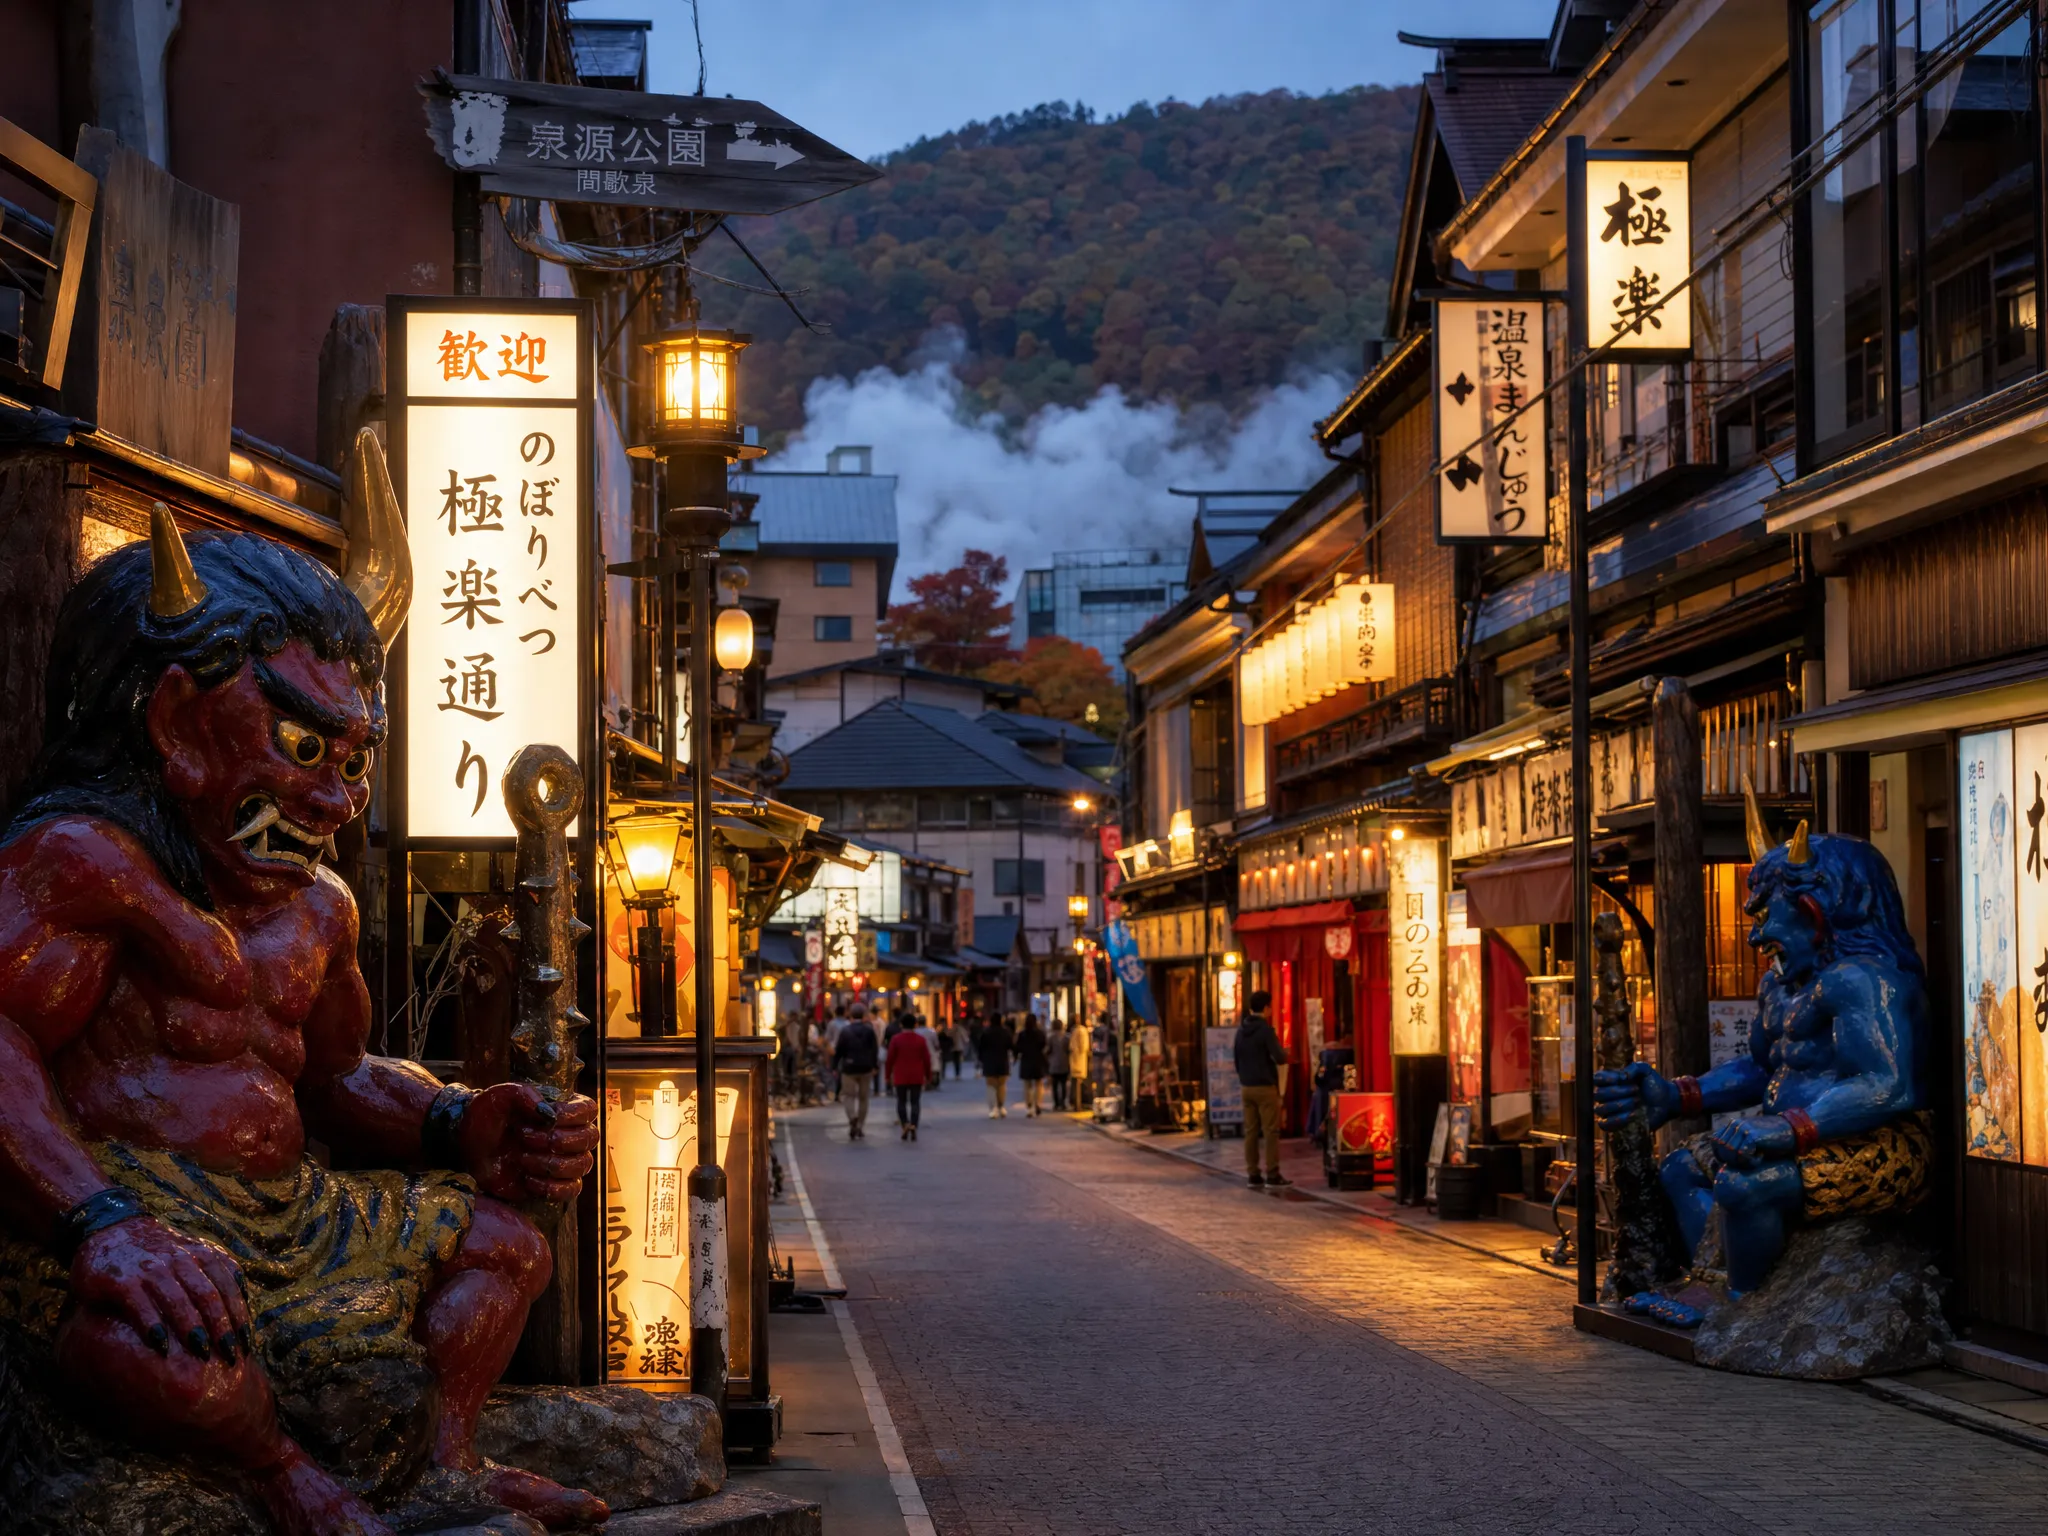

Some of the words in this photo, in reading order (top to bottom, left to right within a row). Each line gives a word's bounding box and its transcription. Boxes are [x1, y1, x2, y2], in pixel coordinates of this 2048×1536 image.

[527, 121, 705, 167] 泉源公園
[1600, 181, 1672, 336] 極楽
[438, 329, 549, 384] 歓迎
[1490, 308, 1529, 533] 温泉まんじゅう
[518, 431, 560, 655] のぼりべつ
[438, 469, 505, 817] 極楽通り
